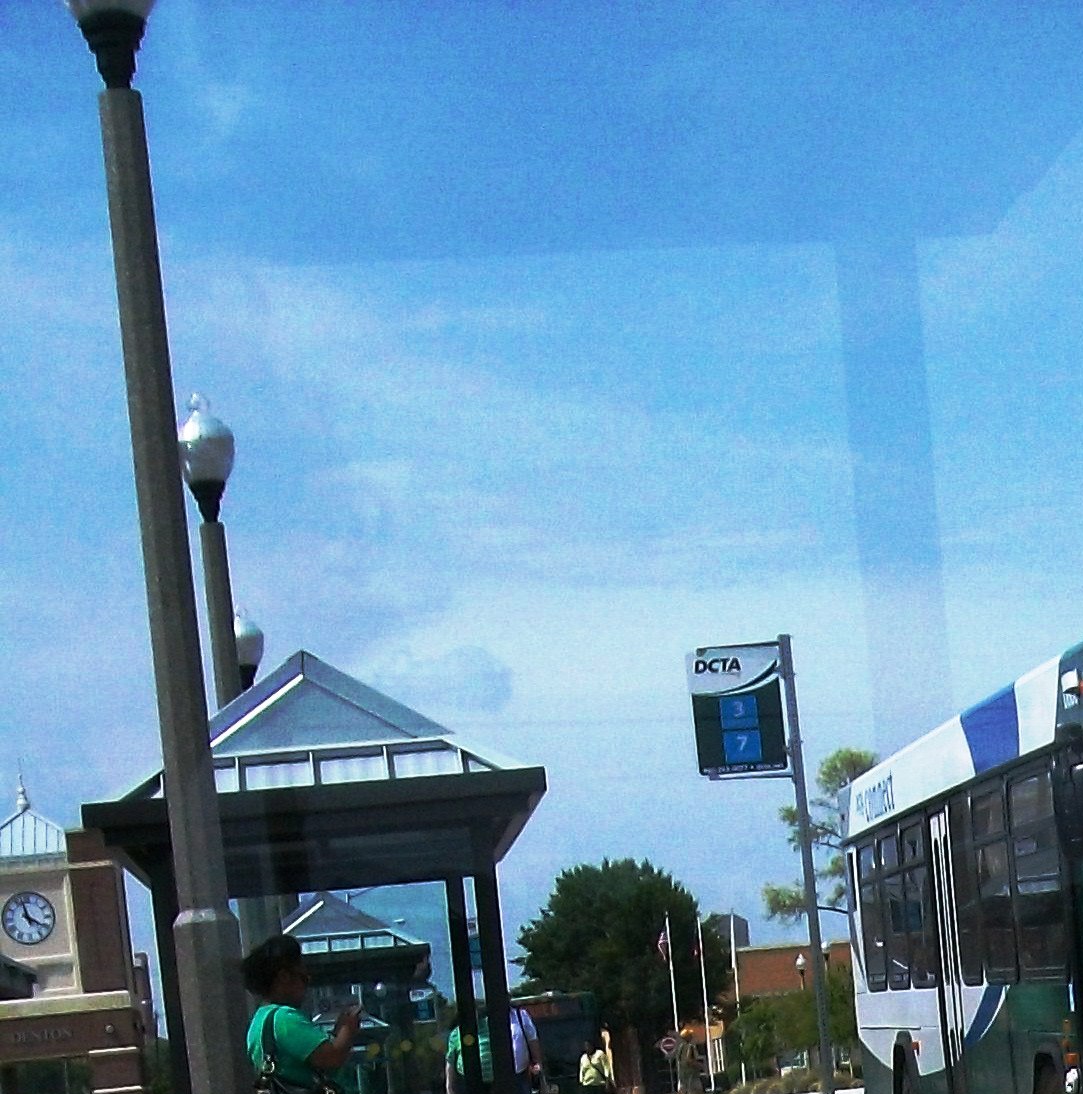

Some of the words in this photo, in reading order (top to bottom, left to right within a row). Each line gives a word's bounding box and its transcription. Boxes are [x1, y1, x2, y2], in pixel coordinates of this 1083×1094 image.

[694, 657, 742, 675] DCTA
[733, 701, 745, 717] 3
[736, 735, 748, 752] 7
